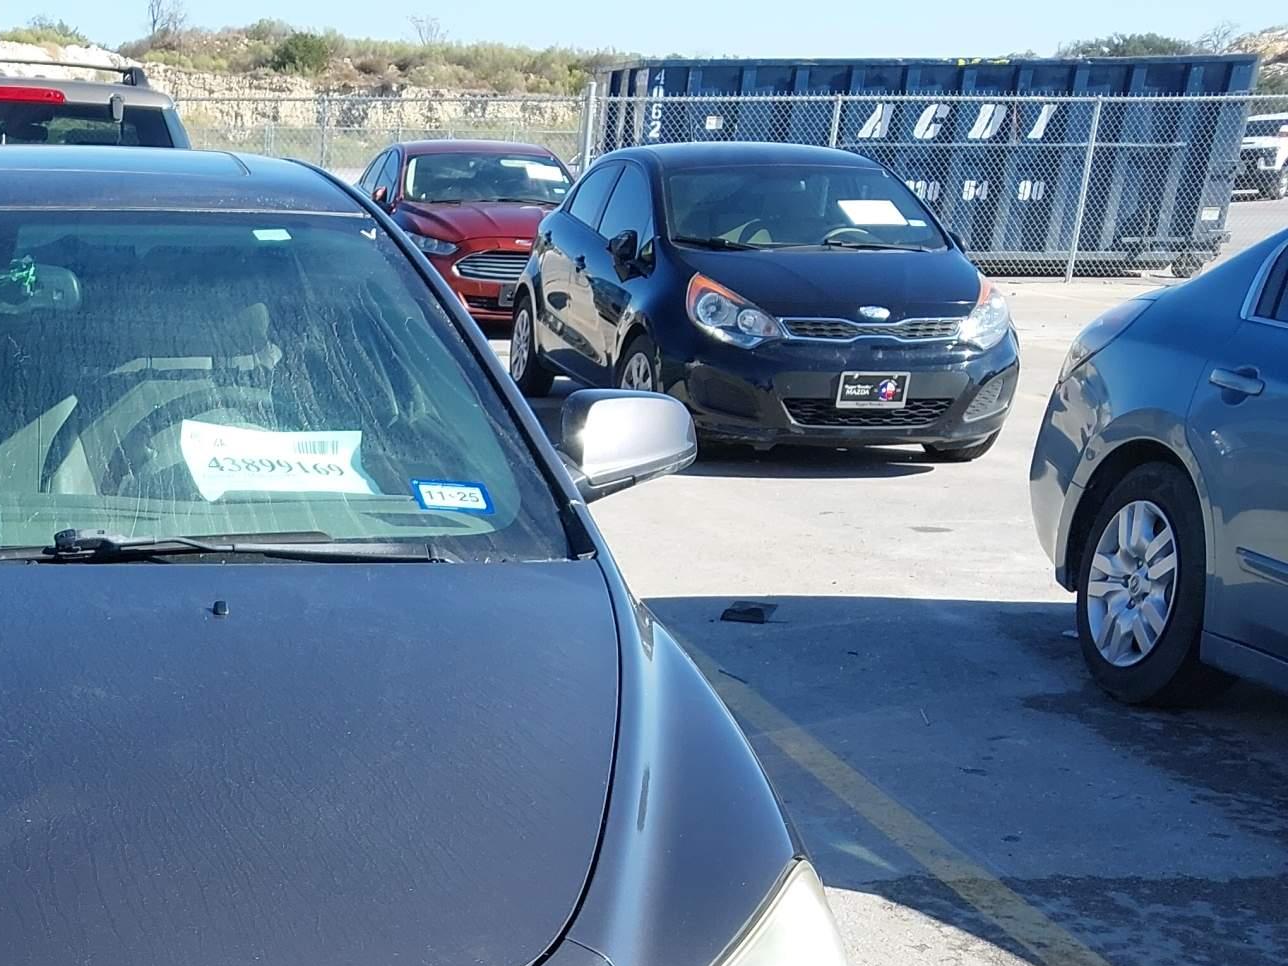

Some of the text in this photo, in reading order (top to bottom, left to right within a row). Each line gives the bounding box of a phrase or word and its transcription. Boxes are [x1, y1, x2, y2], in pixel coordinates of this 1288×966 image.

[962, 180, 989, 201] 54
[1017, 180, 1046, 201] 90
[208, 456, 345, 477] 43899169
[425, 490, 480, 503] 11-25
